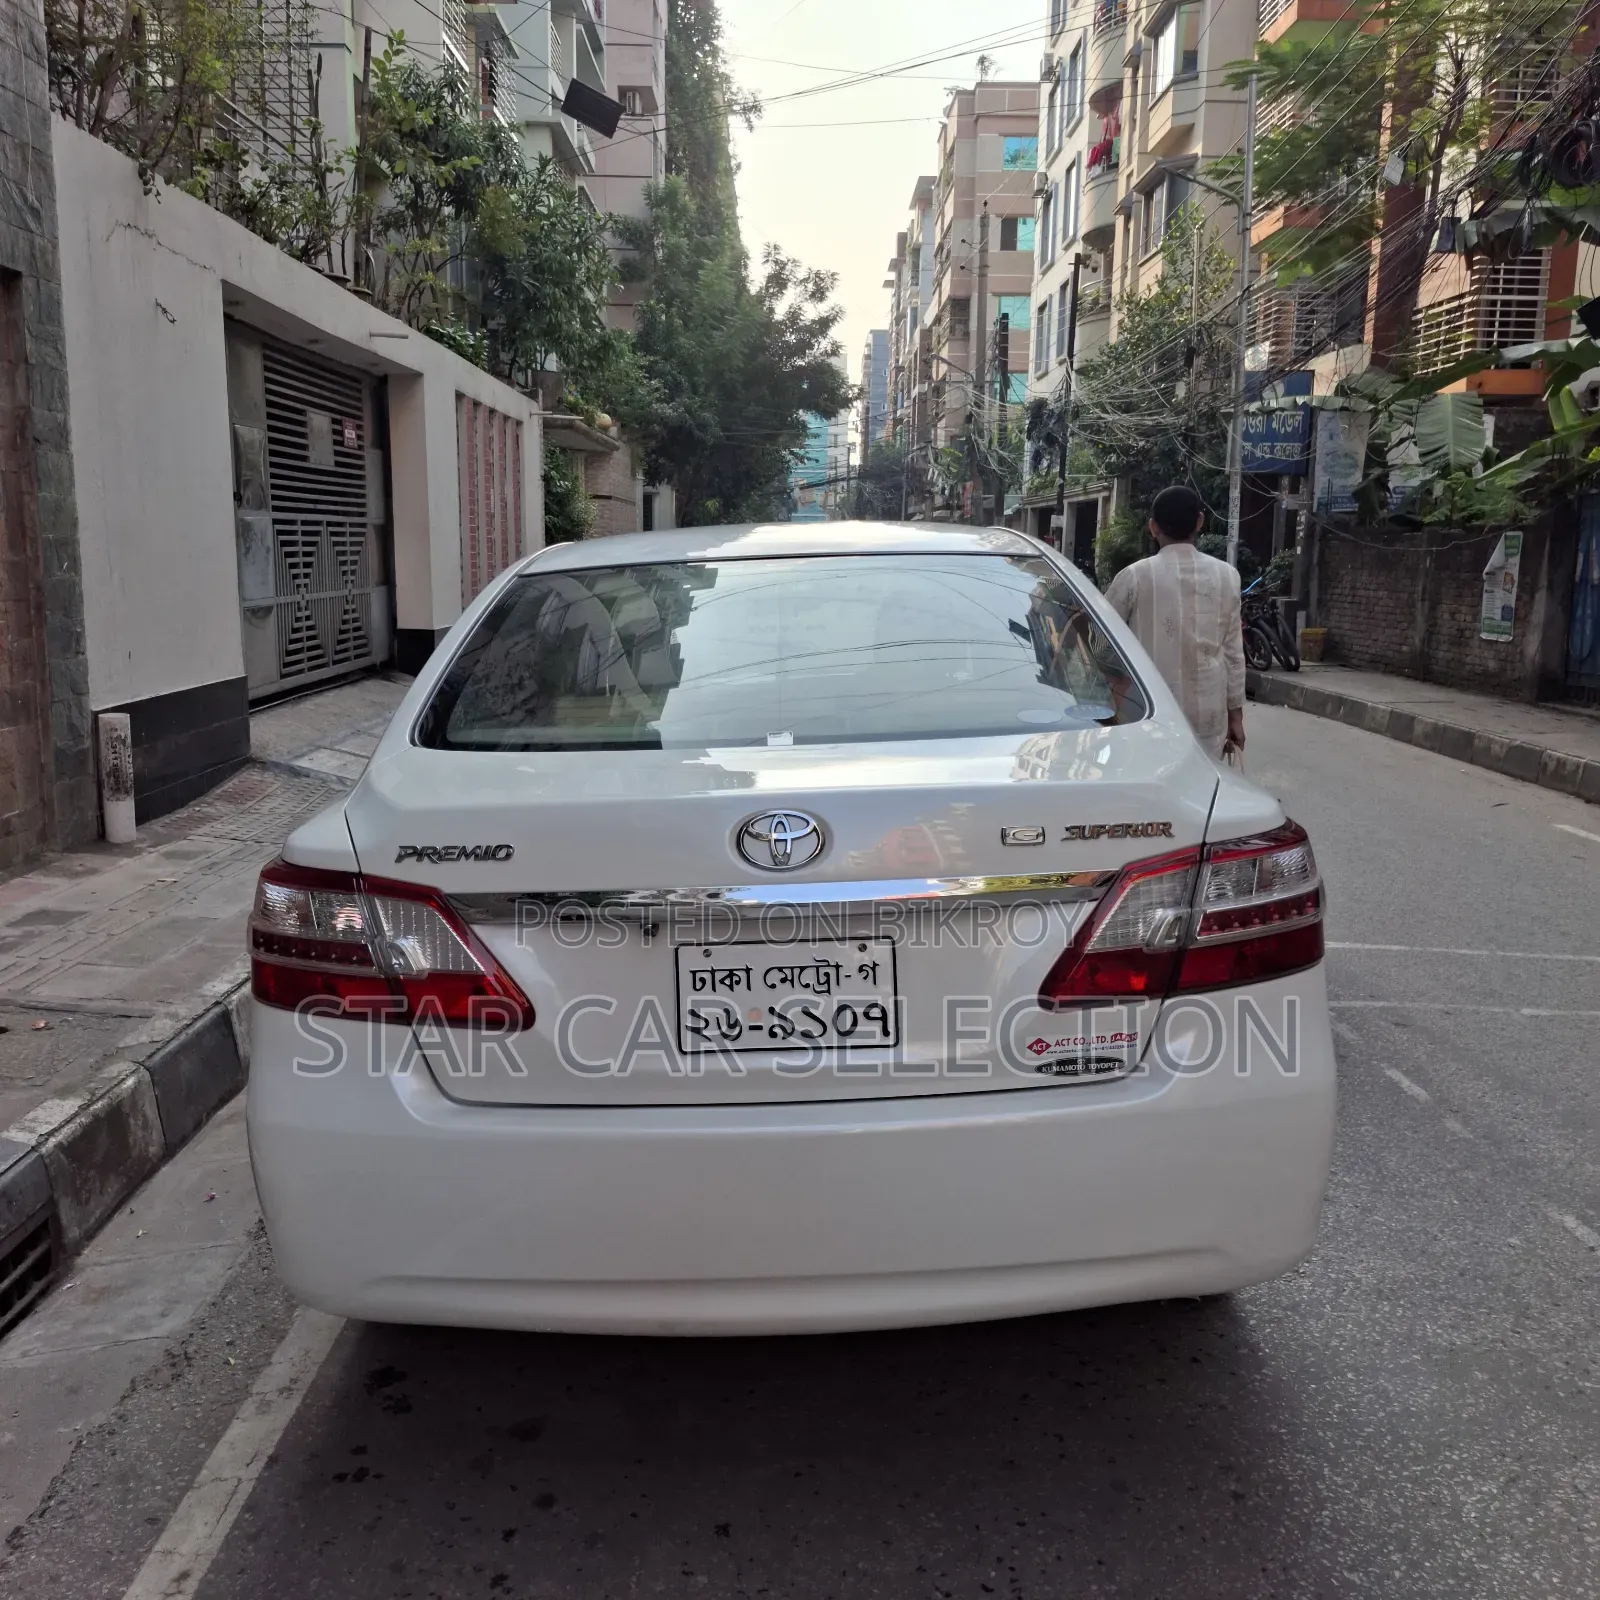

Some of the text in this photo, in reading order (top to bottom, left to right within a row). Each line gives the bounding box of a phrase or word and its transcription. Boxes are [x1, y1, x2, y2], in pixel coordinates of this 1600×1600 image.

[1271, 411, 1305, 434] মডেল
[1060, 821, 1175, 841] SUPERIOR
[394, 844, 515, 864] PREMIO
[689, 964, 753, 993] ঢাকা
[685, 1002, 891, 1042] ২৬-৯১০৭
[1031, 1042, 1047, 1051] ACT
[1054, 1038, 1071, 1047] ACT
[1111, 1033, 1138, 1043] JAPAN
[1042, 1062, 1119, 1073] KUMAMOTO TOYOPET
